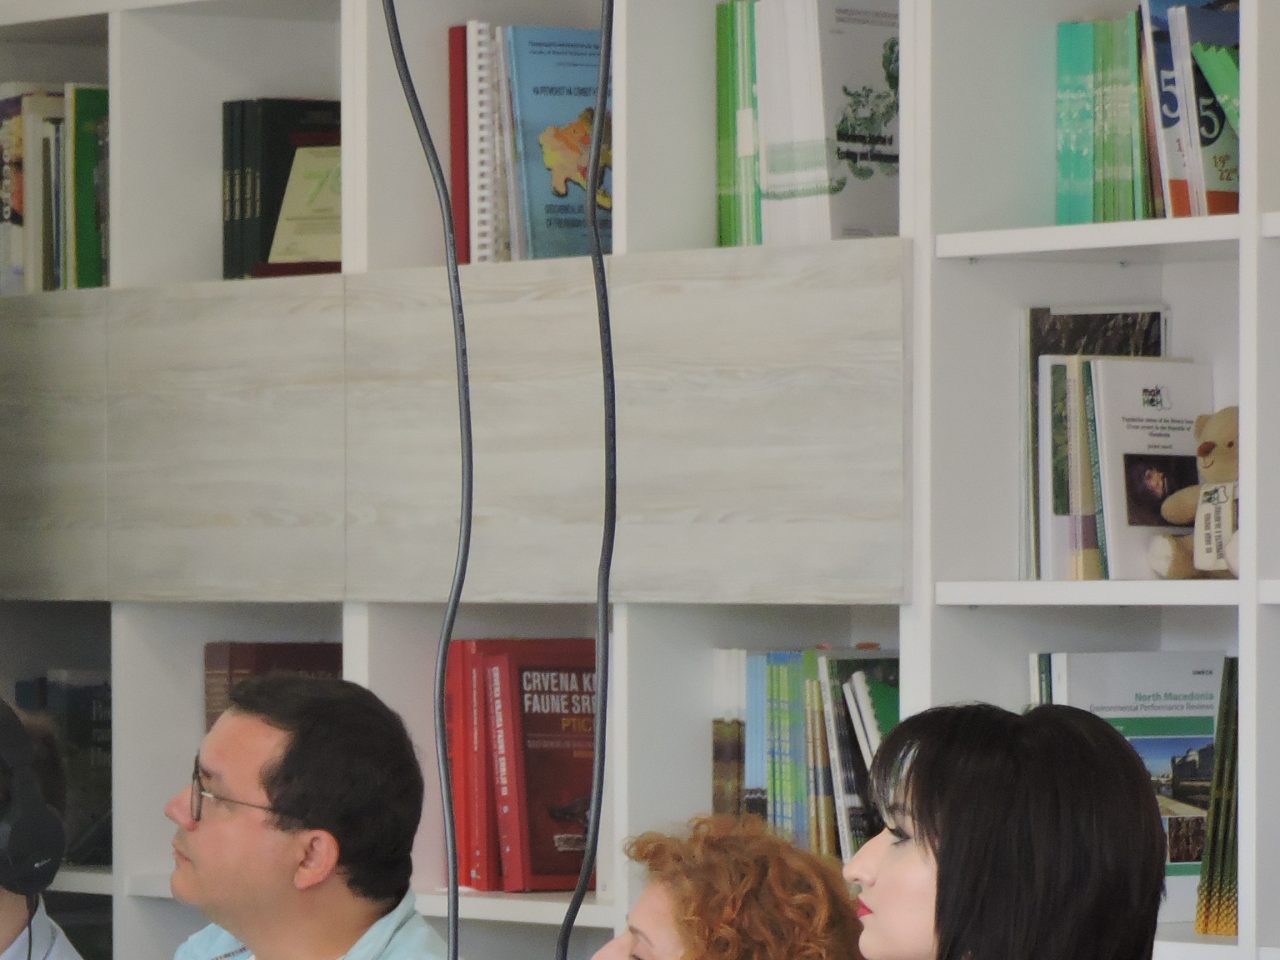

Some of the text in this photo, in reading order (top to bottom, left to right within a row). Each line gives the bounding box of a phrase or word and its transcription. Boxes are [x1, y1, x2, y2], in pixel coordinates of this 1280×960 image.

[522, 671, 579, 692] CRVENA
[523, 693, 569, 713] FAUNE
[1135, 691, 1215, 702] North Macedonia
